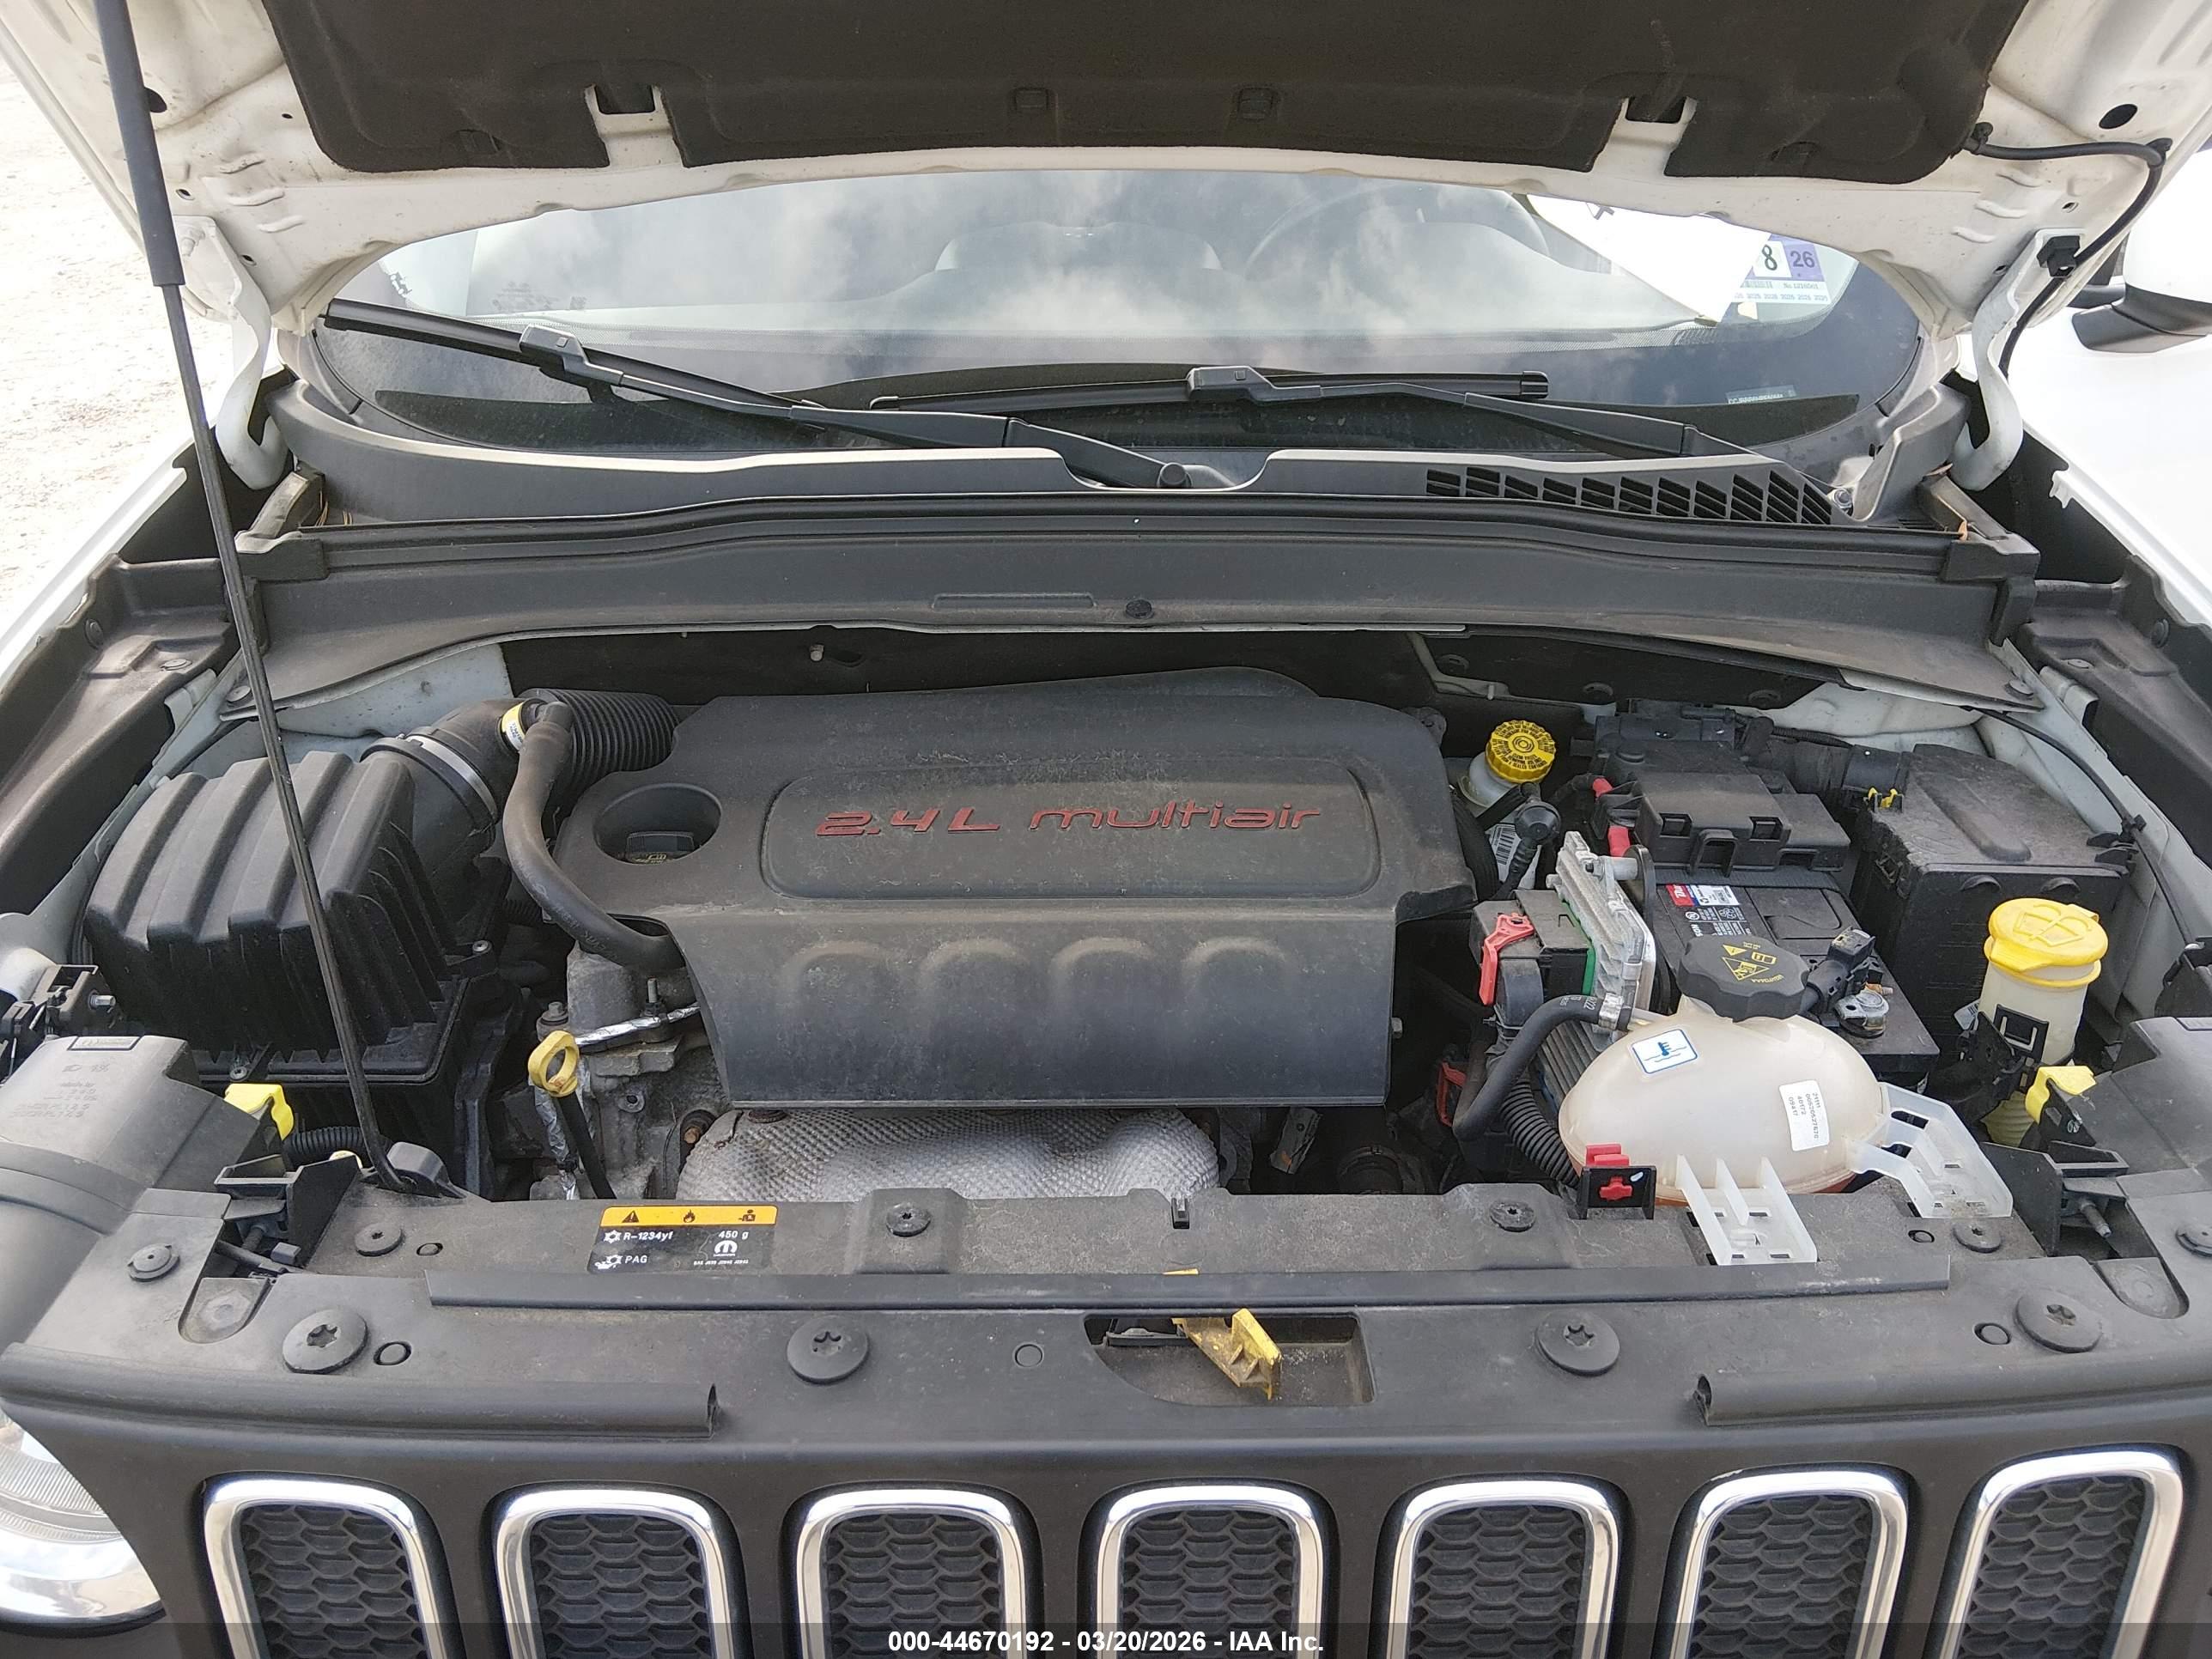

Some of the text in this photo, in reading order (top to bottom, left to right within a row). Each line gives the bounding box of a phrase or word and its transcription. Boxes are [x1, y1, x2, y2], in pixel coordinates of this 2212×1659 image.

[1761, 244, 1815, 270] 8 26
[1030, 800, 1322, 831] multiair
[623, 1230, 749, 1243] R-1234yf 450 g
[625, 1255, 648, 1264] PAG
